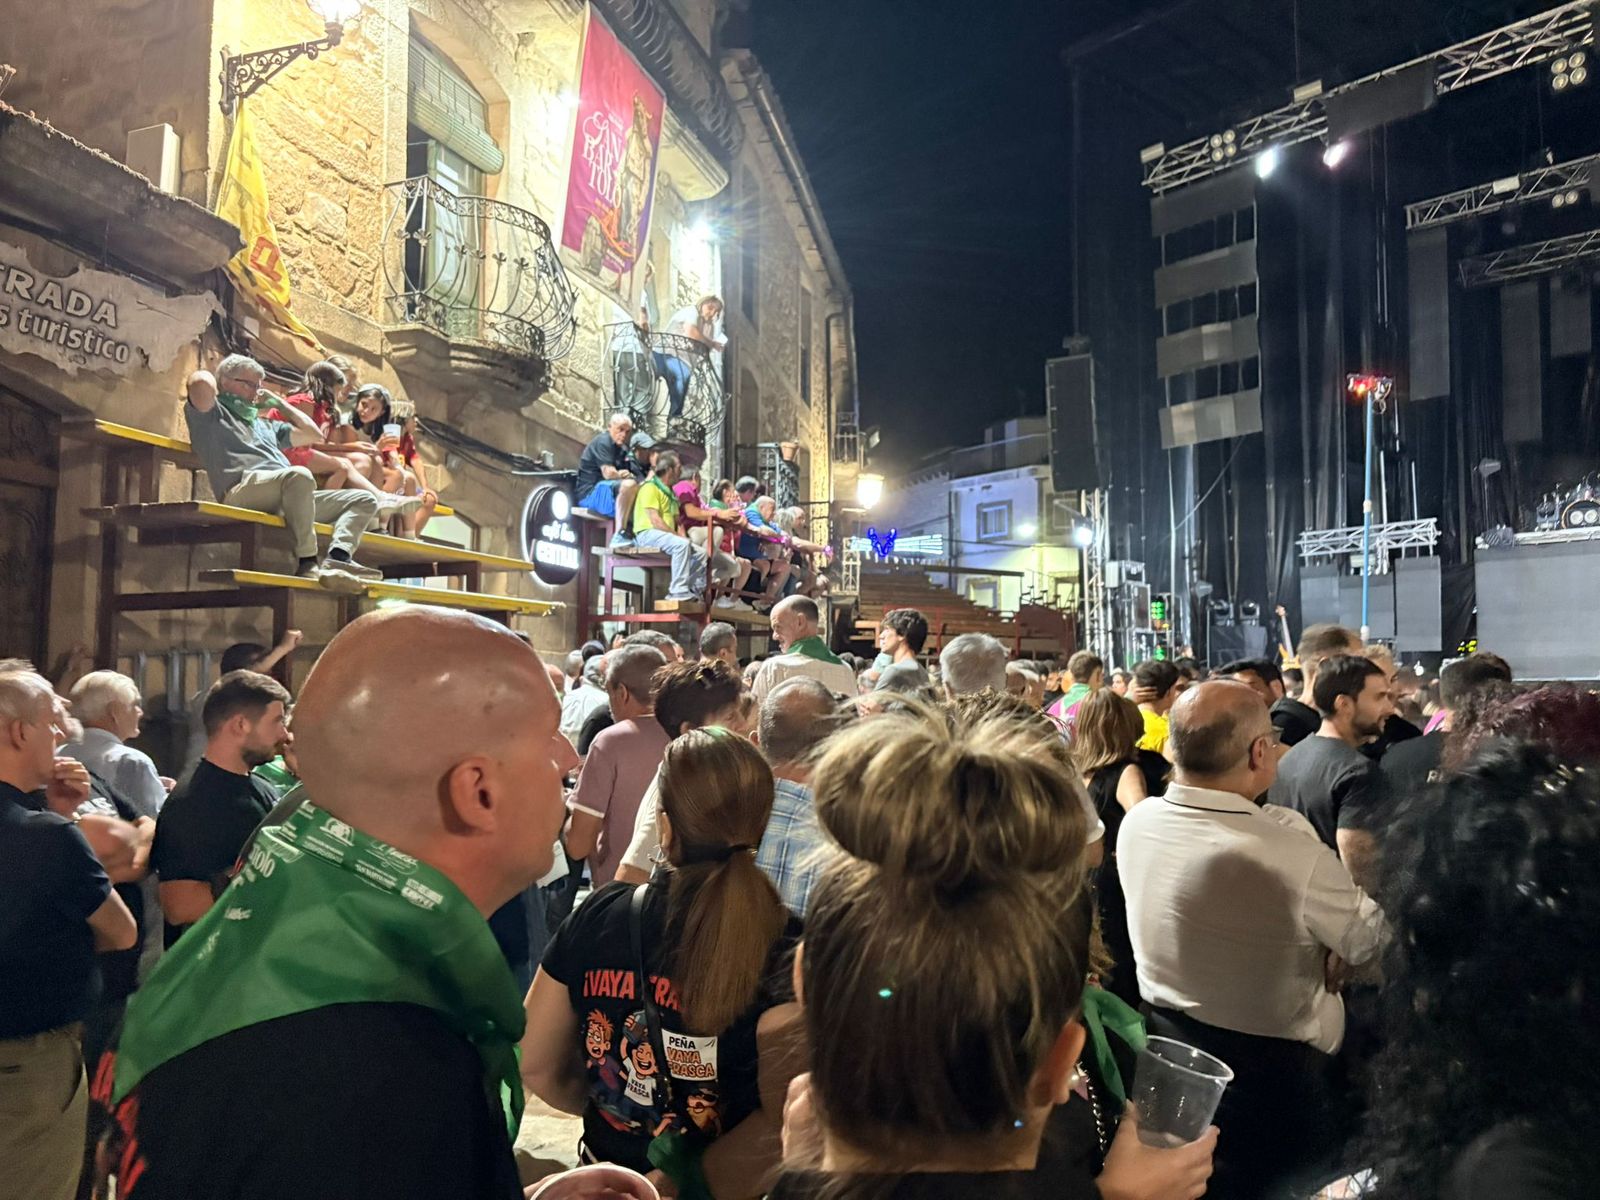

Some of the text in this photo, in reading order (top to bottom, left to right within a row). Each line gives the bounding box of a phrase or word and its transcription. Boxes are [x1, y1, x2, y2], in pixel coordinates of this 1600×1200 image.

[0, 264, 118, 328] RADA
[17, 307, 130, 365] turistico
[668, 1036, 696, 1050] PEÑA
[666, 1046, 702, 1065] VAYA
[667, 1060, 716, 1078] RASCA
